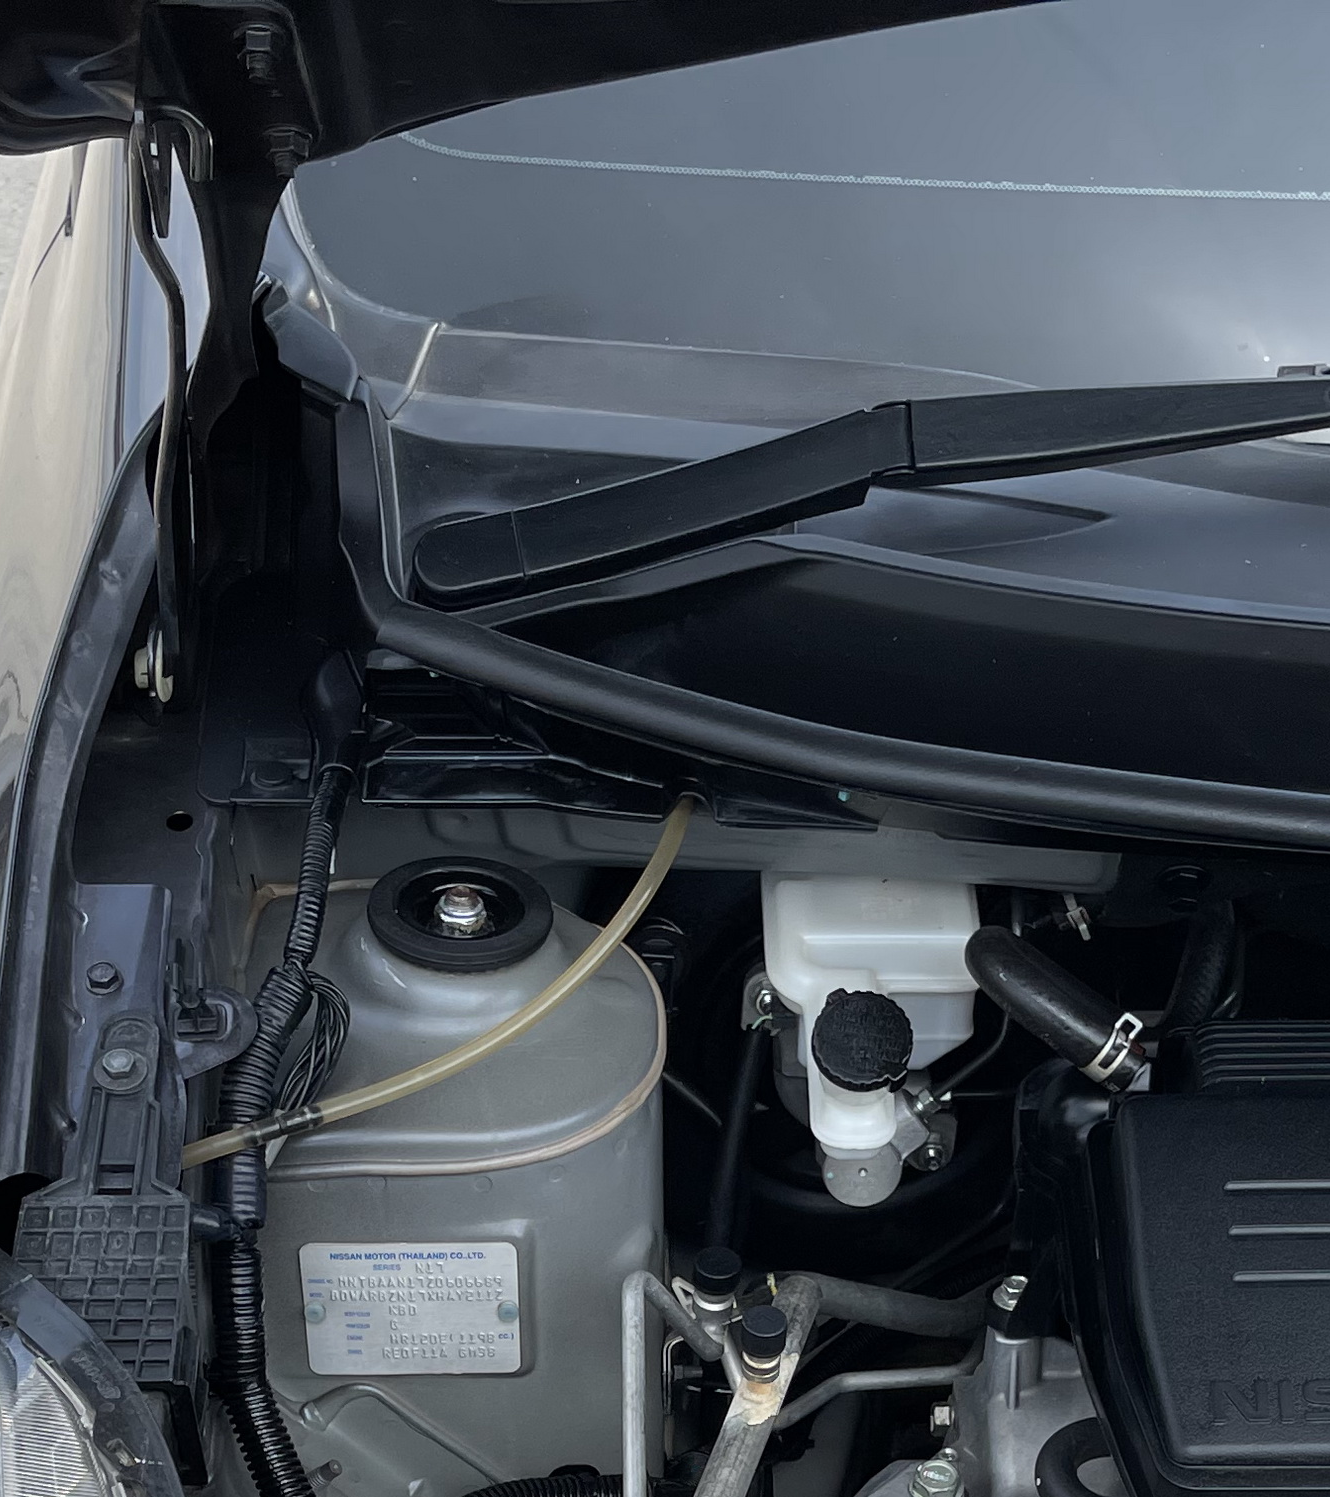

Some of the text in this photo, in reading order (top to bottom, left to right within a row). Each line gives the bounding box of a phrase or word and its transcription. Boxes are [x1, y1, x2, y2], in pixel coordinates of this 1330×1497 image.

[329, 1252, 362, 1260] NISSAN
[364, 1252, 396, 1260] MOTOR
[398, 1252, 448, 1261] (THAILAND)
[372, 1261, 445, 1274] SERIES N17
